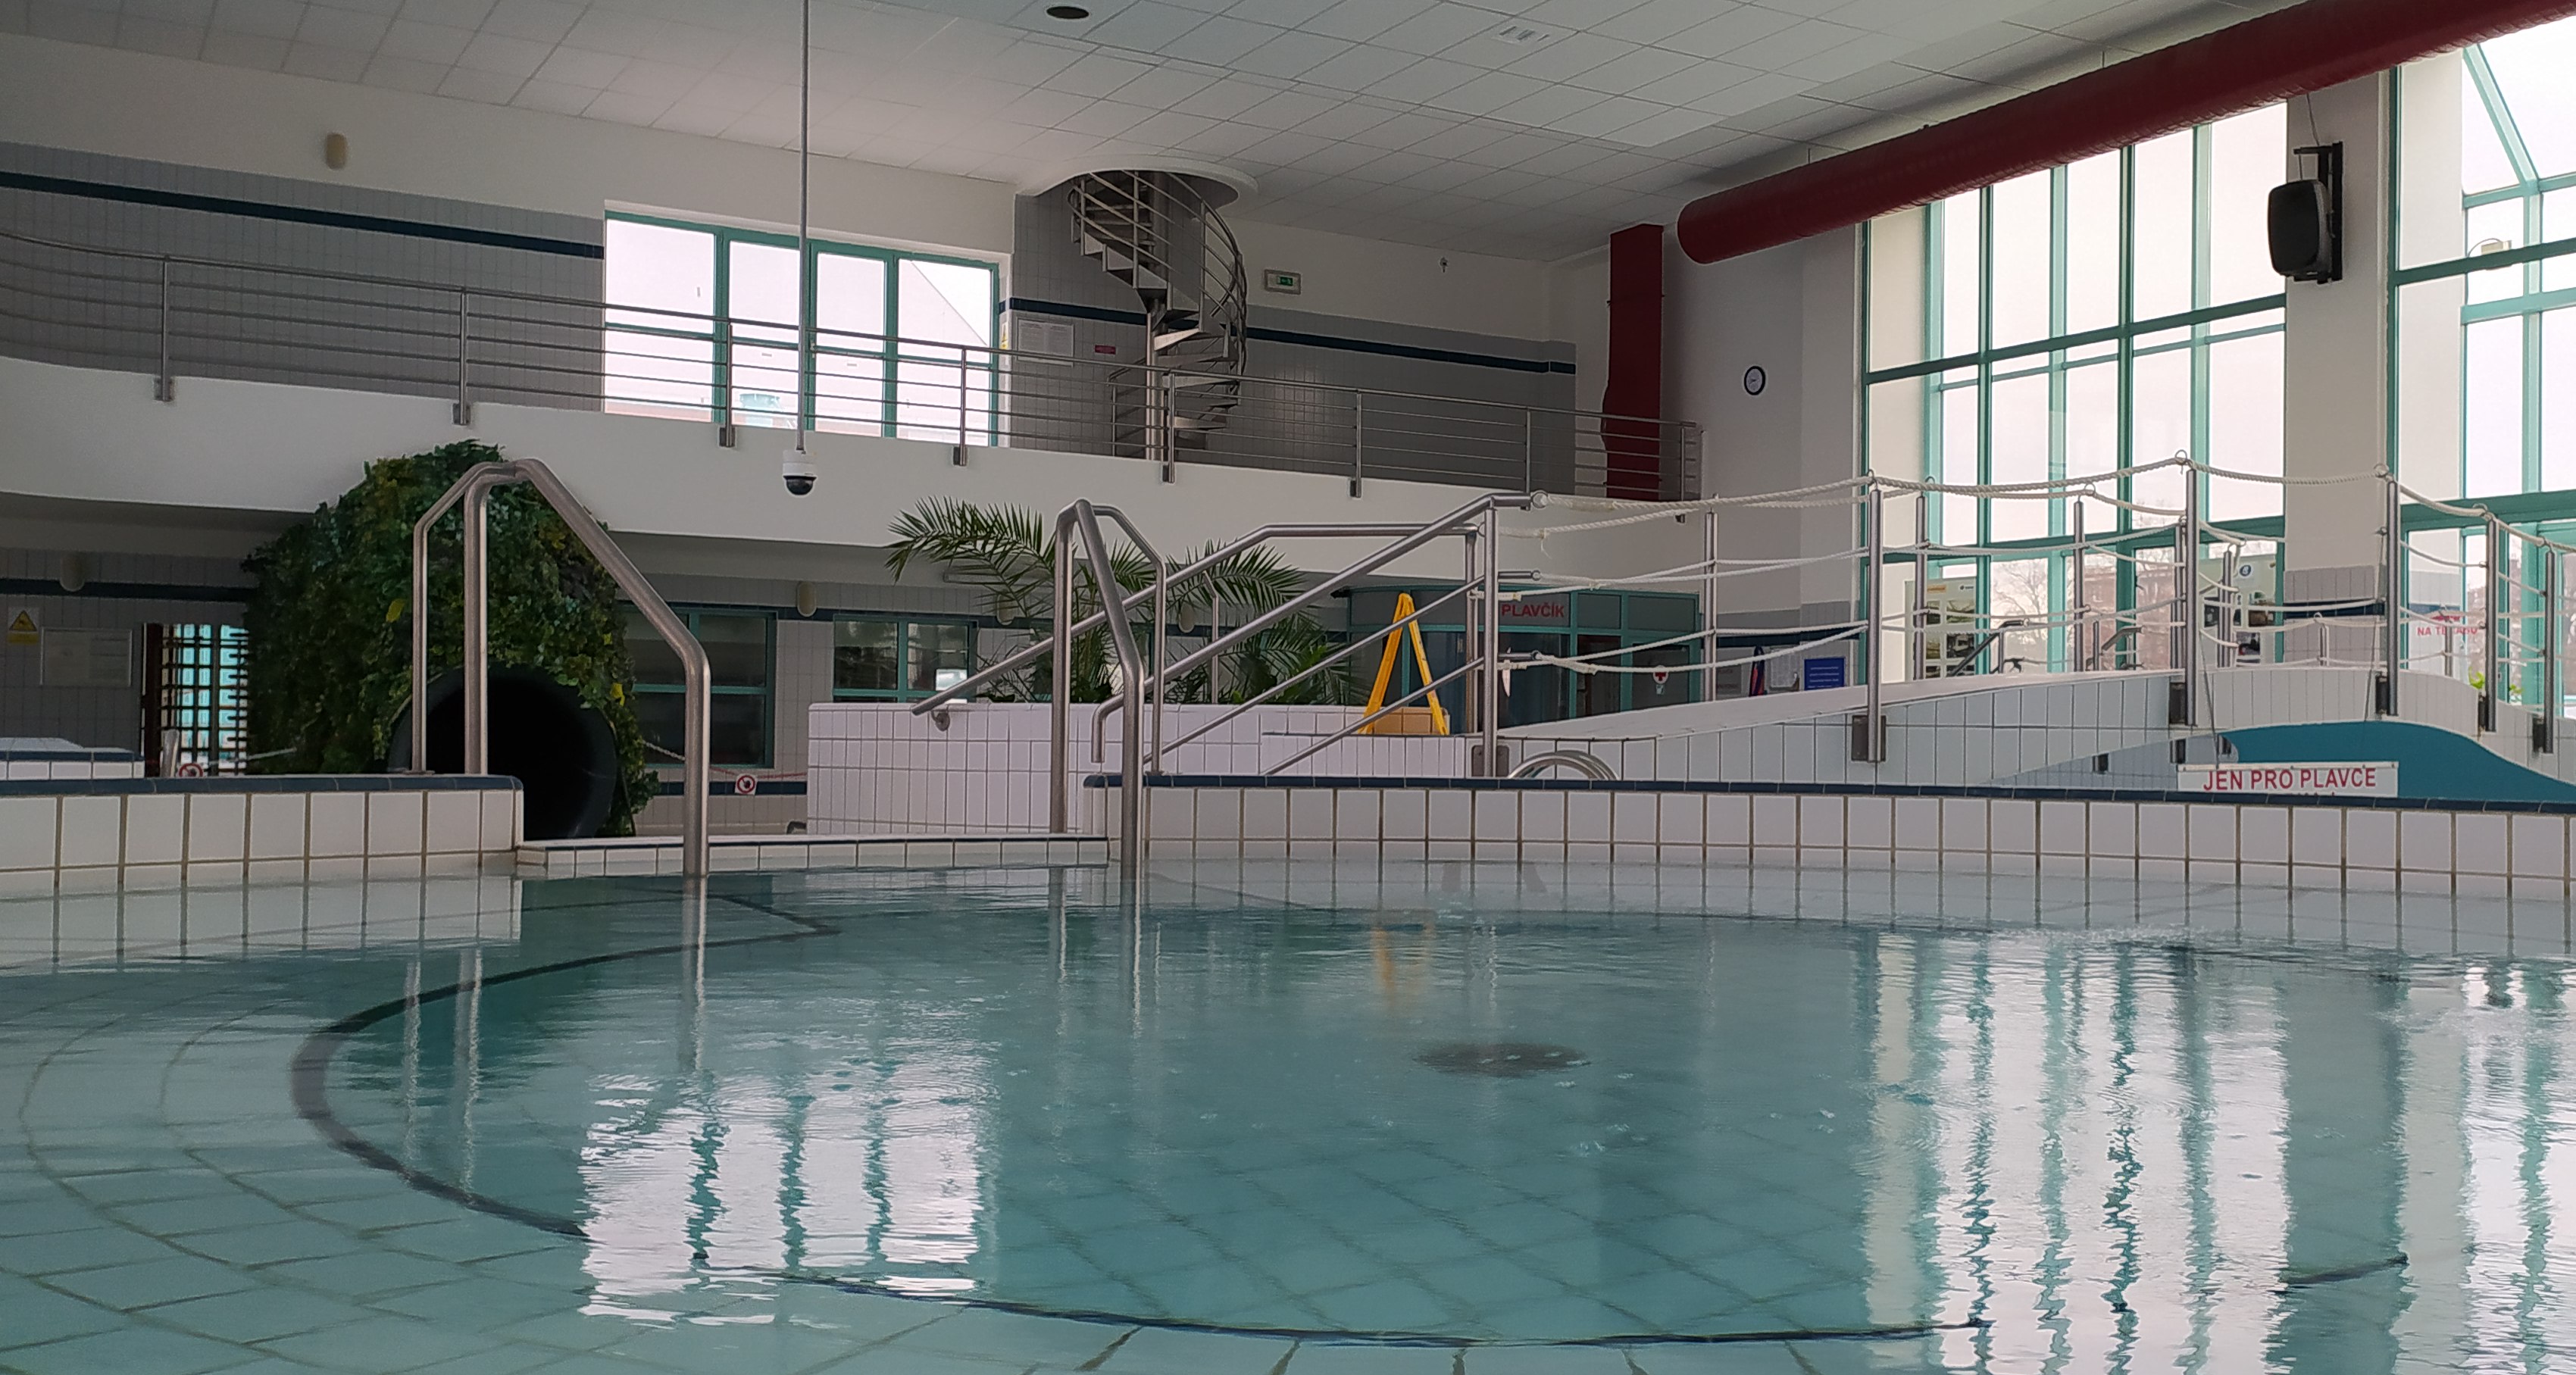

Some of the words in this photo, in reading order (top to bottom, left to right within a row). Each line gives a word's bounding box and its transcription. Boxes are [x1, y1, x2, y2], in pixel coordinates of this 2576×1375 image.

[1501, 602, 1565, 617] PLAVČÍK
[2417, 627, 2432, 636] NA
[2203, 770, 2243, 791] JEN
[2250, 769, 2293, 789] PRO
[2300, 767, 2376, 789] PLAVCE
